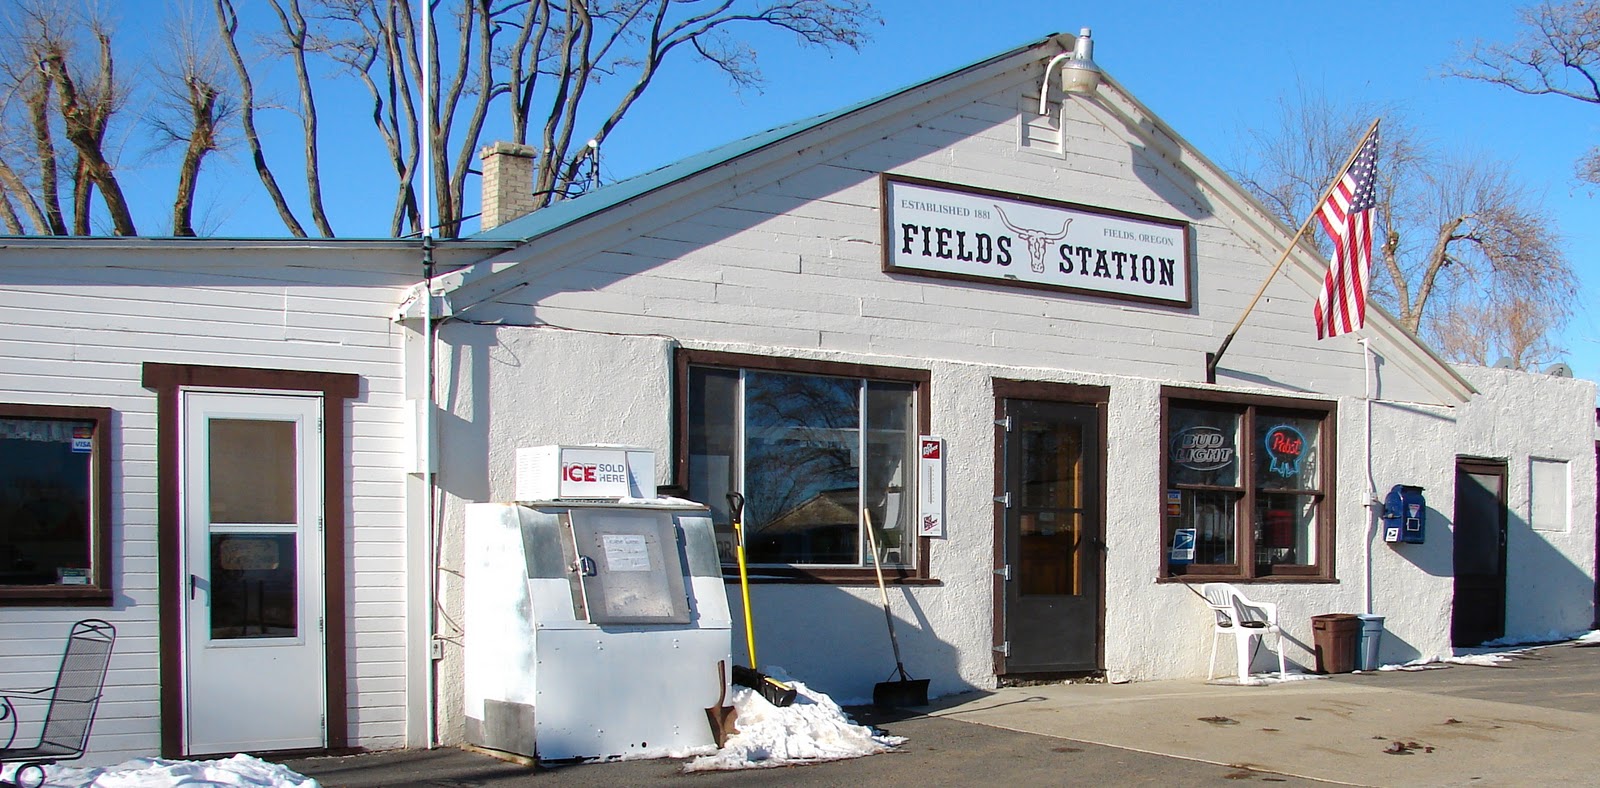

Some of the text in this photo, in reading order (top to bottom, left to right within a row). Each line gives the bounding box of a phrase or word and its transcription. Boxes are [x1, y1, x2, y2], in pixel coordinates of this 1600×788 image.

[901, 199, 991, 219] ESTABLISHED 1881
[1138, 233, 1174, 246] OREGON
[901, 223, 1175, 287] FIELDS STATION
[1183, 433, 1224, 448] BUD
[1272, 431, 1302, 455] Pabst
[1176, 447, 1233, 463] LIGHT
[562, 462, 625, 482] ICE SOLD
[599, 474, 626, 483] HERE
